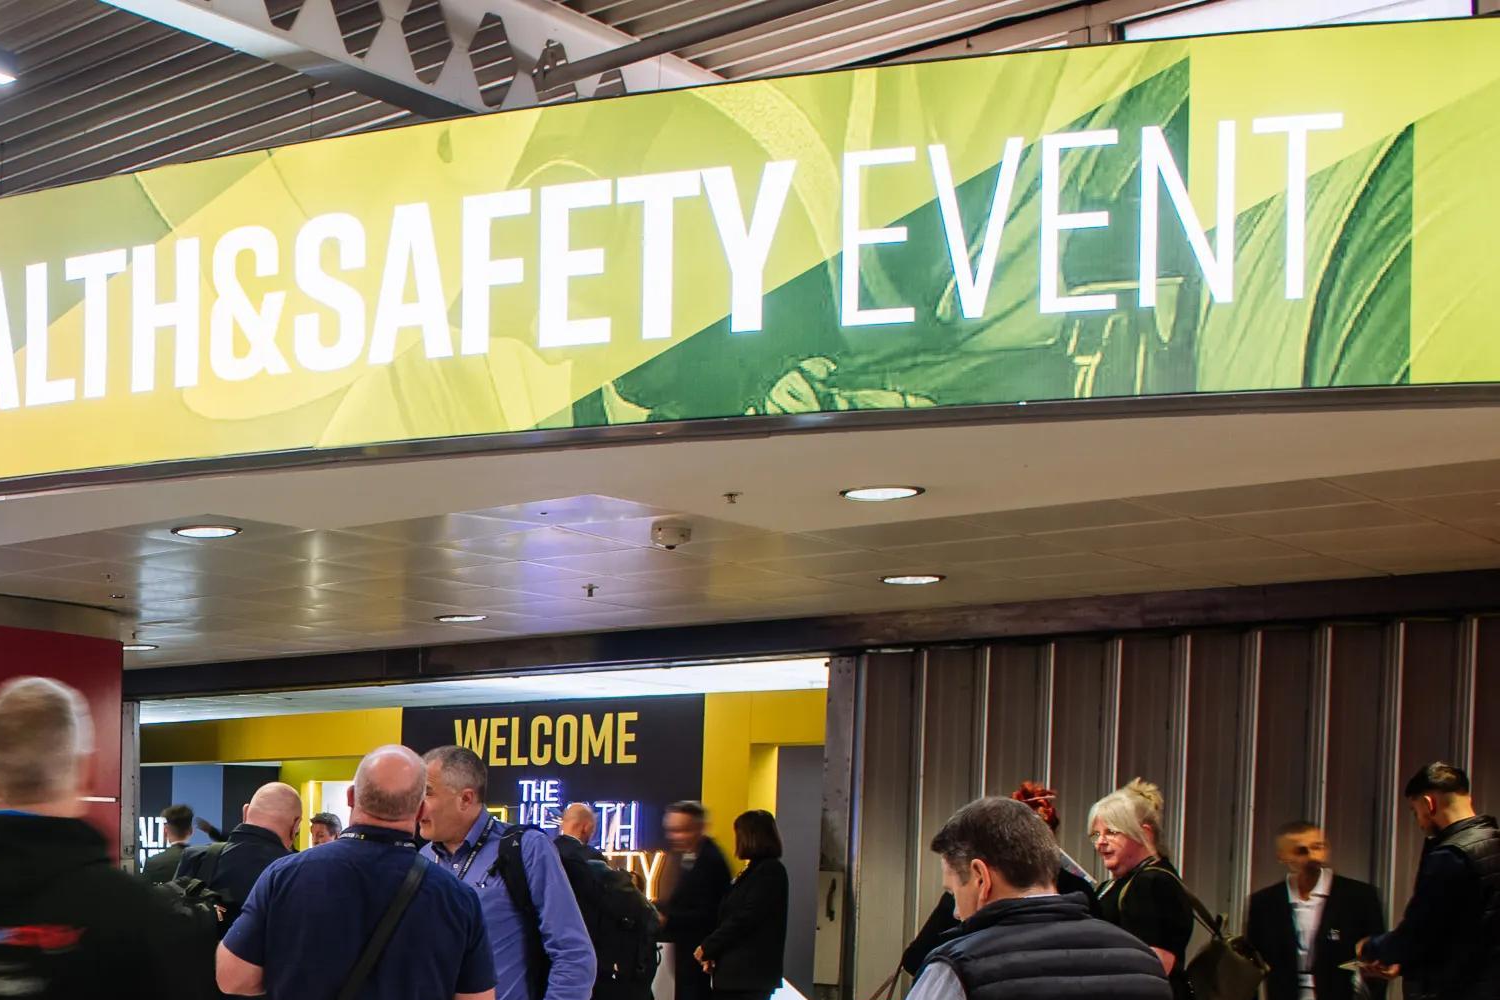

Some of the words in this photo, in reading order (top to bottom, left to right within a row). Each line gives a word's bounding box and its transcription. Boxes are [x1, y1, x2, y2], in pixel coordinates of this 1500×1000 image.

[840, 112, 1344, 327] EVENT
[454, 711, 639, 767] WELCOME
[518, 779, 560, 803] THE
